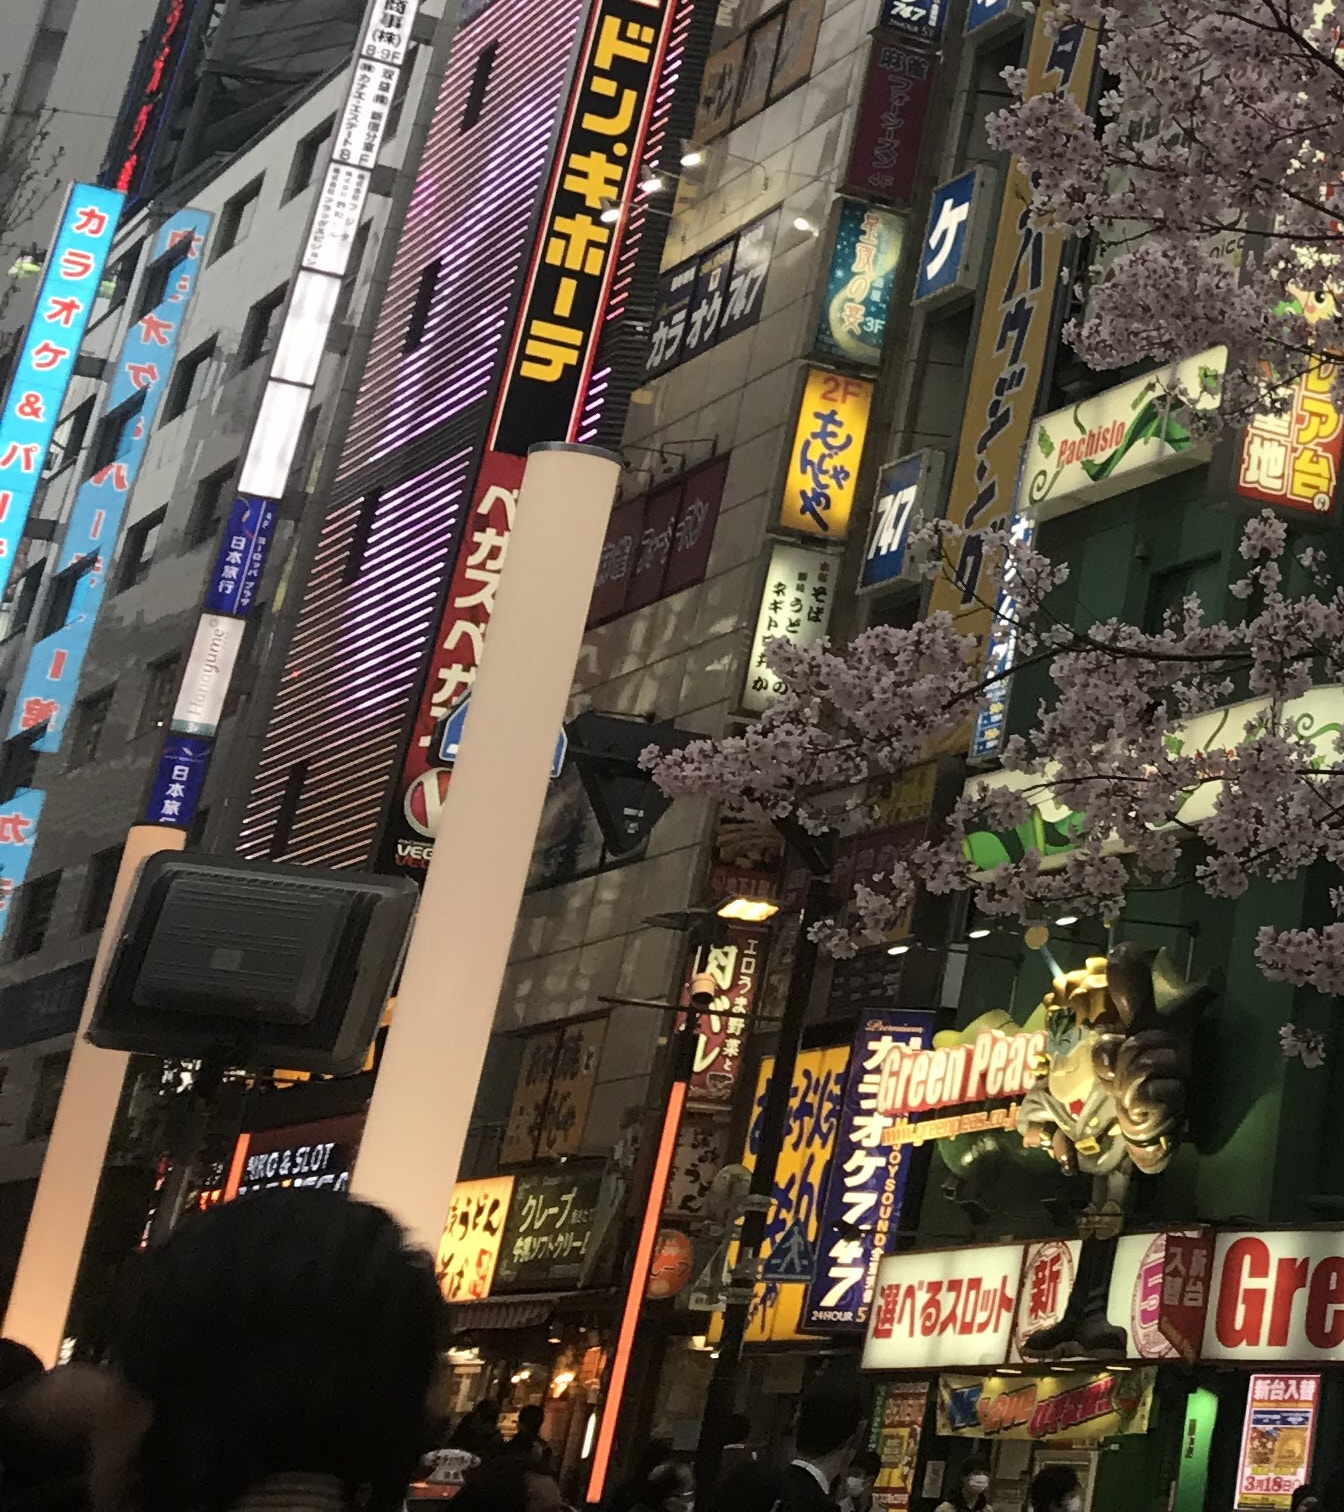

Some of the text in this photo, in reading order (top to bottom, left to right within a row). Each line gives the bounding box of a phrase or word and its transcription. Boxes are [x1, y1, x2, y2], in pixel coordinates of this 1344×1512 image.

[891, 0, 927, 22] 747
[512, 12, 657, 384] ドン・キホーテ
[862, 316, 886, 334] 3F
[822, 376, 863, 404] 2F
[1056, 419, 1126, 470] Pachislo
[866, 484, 918, 561] 747
[218, 535, 247, 595] 日本旅行
[159, 764, 192, 823] 日本旅
[876, 1028, 1044, 1114] Green Peas
[880, 1101, 1021, 1148] www.greenpeas.co.j
[518, 1185, 579, 1234] クレープ
[871, 1273, 1014, 1341] 選べるスロット
[1253, 1378, 1317, 1402] 新台入替
